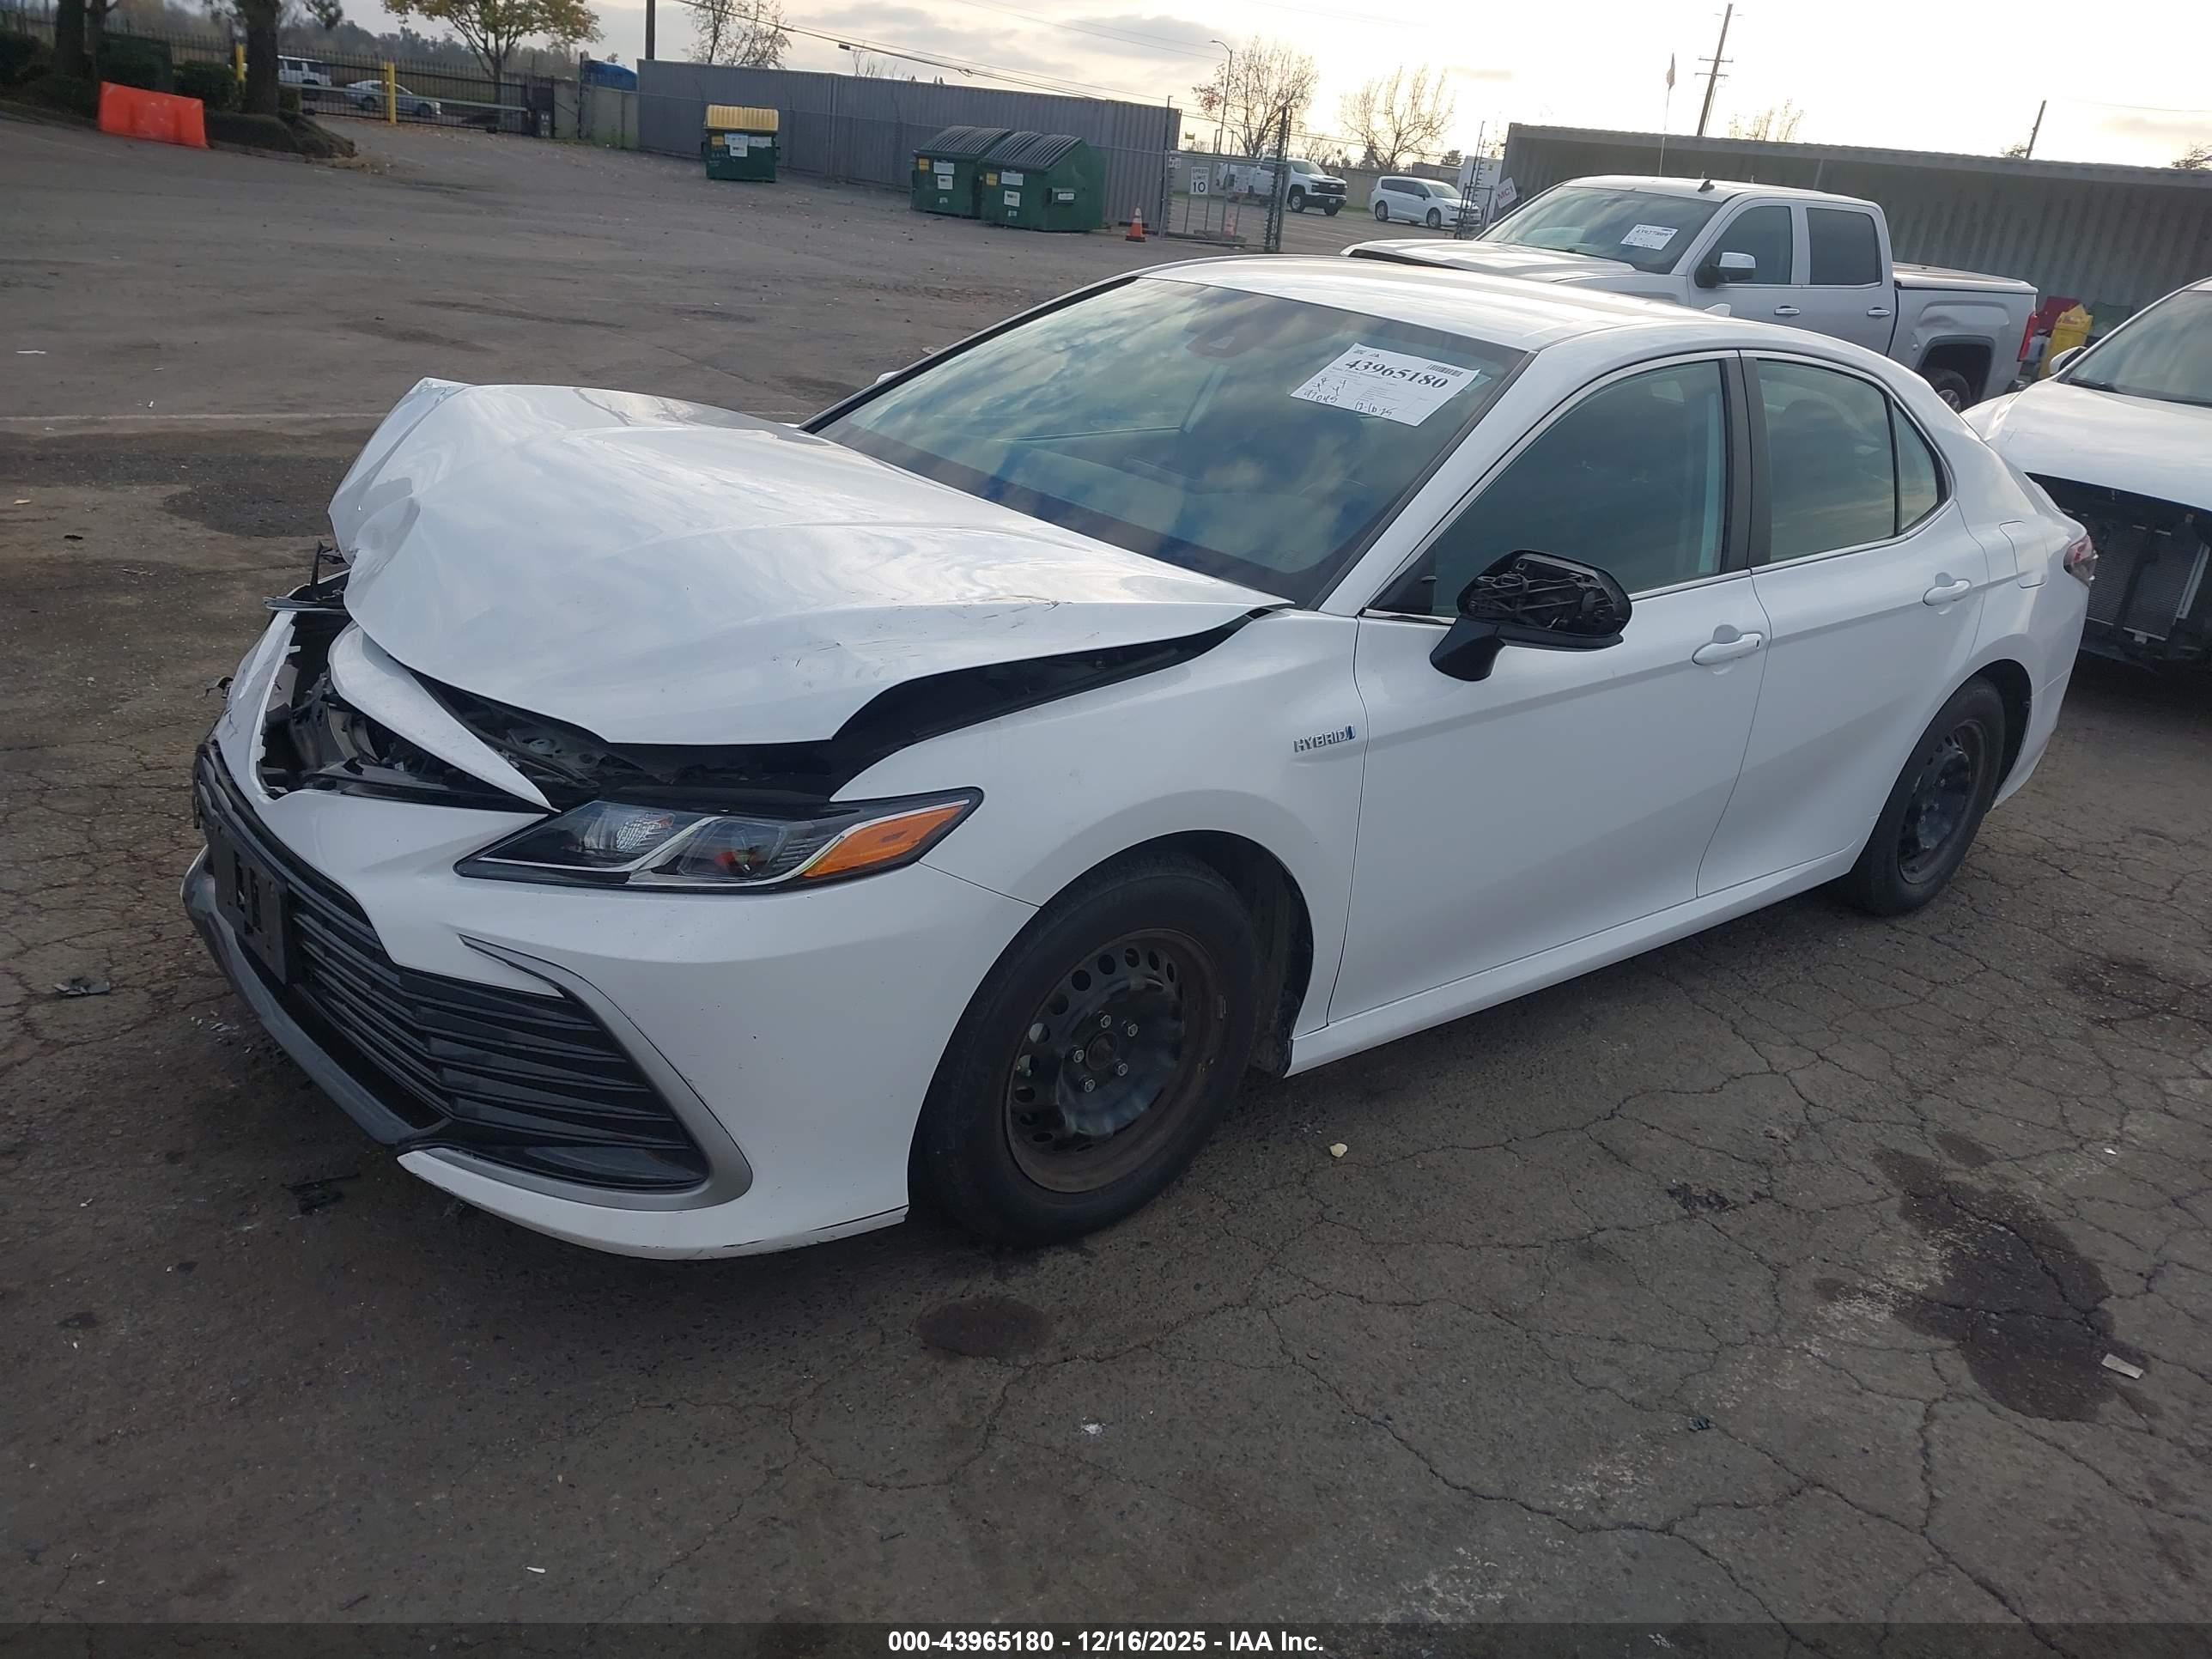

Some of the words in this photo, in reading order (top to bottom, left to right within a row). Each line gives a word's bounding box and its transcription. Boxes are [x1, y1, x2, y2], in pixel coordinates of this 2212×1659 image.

[1194, 181, 1206, 192] 10
[1345, 360, 1449, 388] 43965180
[1293, 729, 1347, 752] HYBRID
